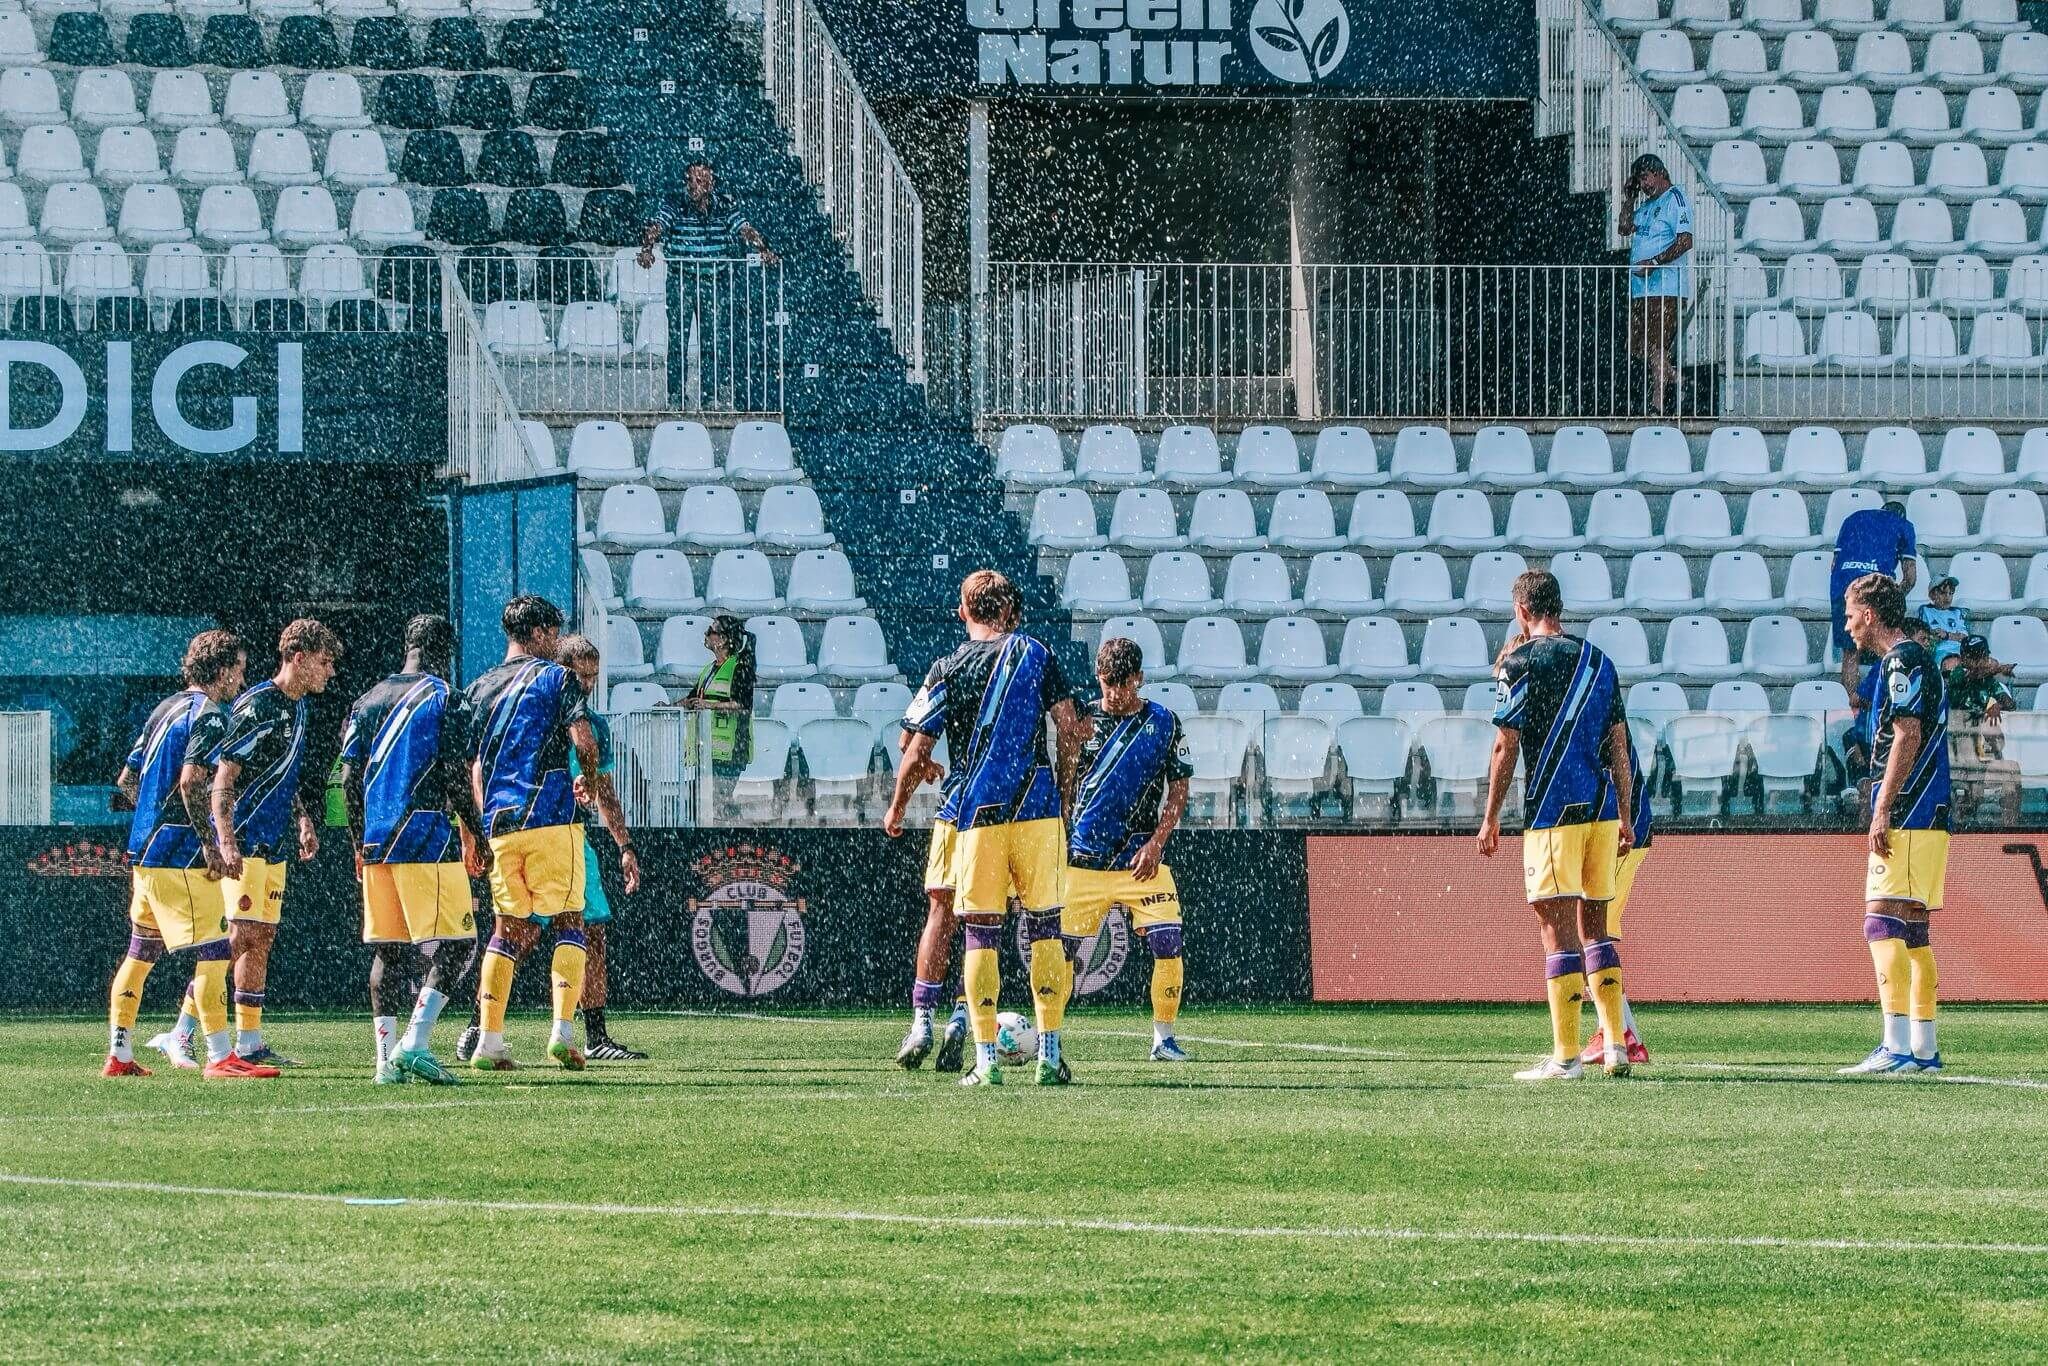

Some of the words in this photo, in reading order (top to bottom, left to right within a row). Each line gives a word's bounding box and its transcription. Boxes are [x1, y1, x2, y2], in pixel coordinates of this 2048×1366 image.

[978, 29, 1232, 85] Natur
[0, 340, 303, 453] DIGI
[726, 883, 767, 899] CLUB
